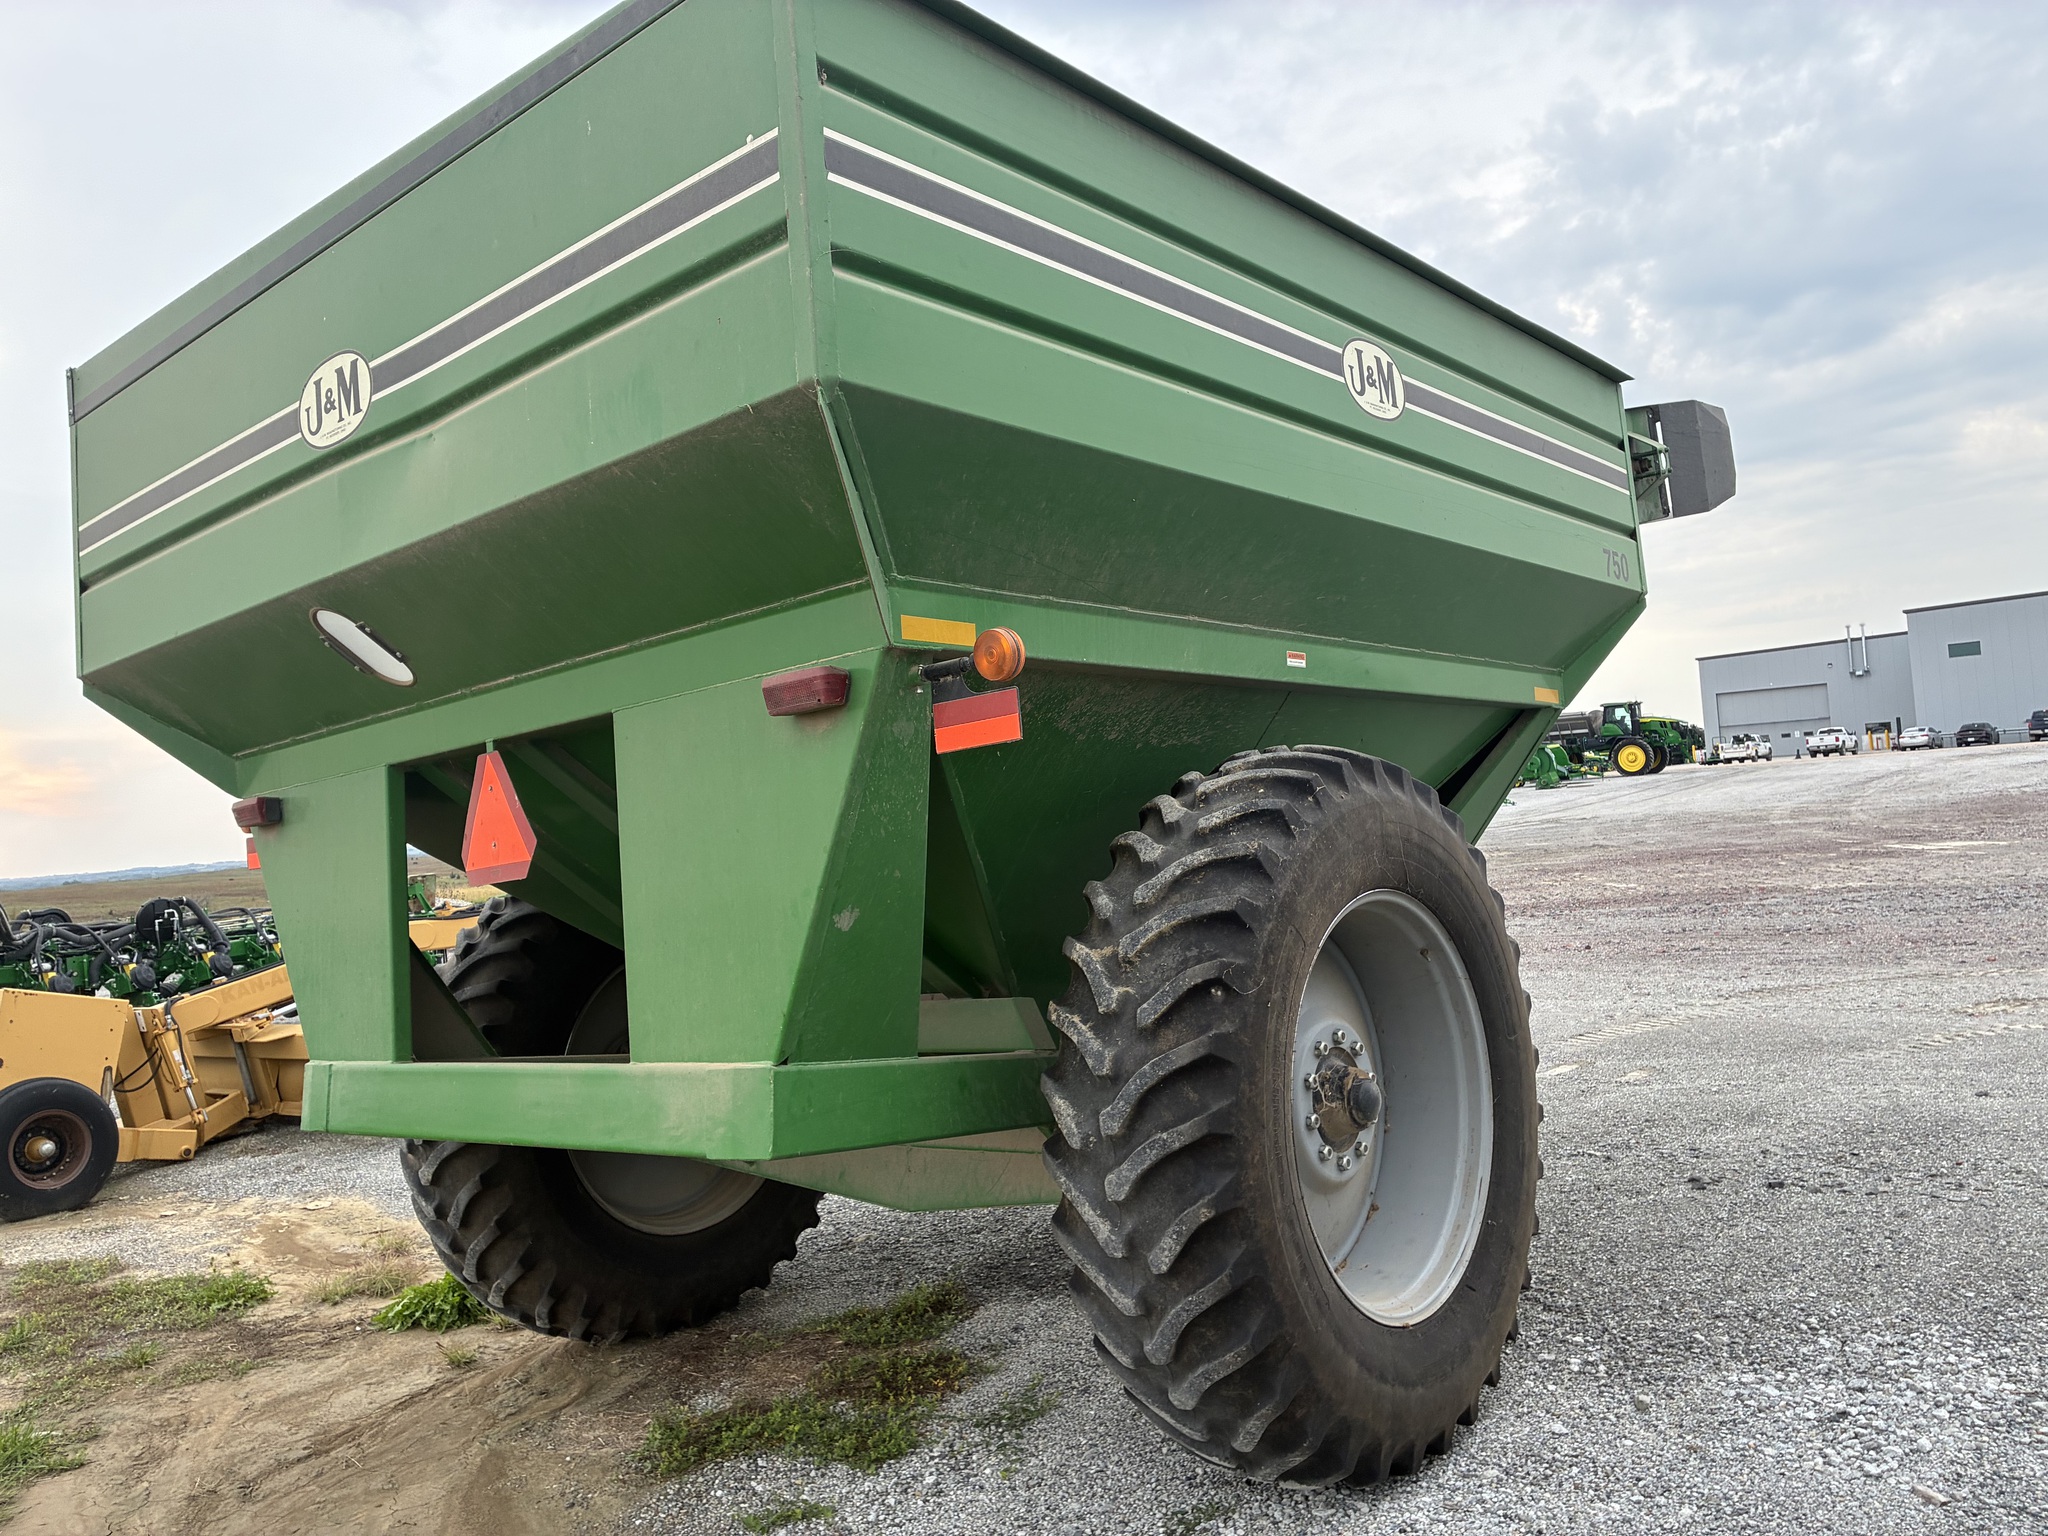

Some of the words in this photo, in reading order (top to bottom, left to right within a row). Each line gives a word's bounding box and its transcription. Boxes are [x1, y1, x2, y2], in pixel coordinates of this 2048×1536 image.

[305, 358, 362, 436] J&M
[1348, 347, 1399, 409] J&M
[1603, 548, 1629, 582] 750
